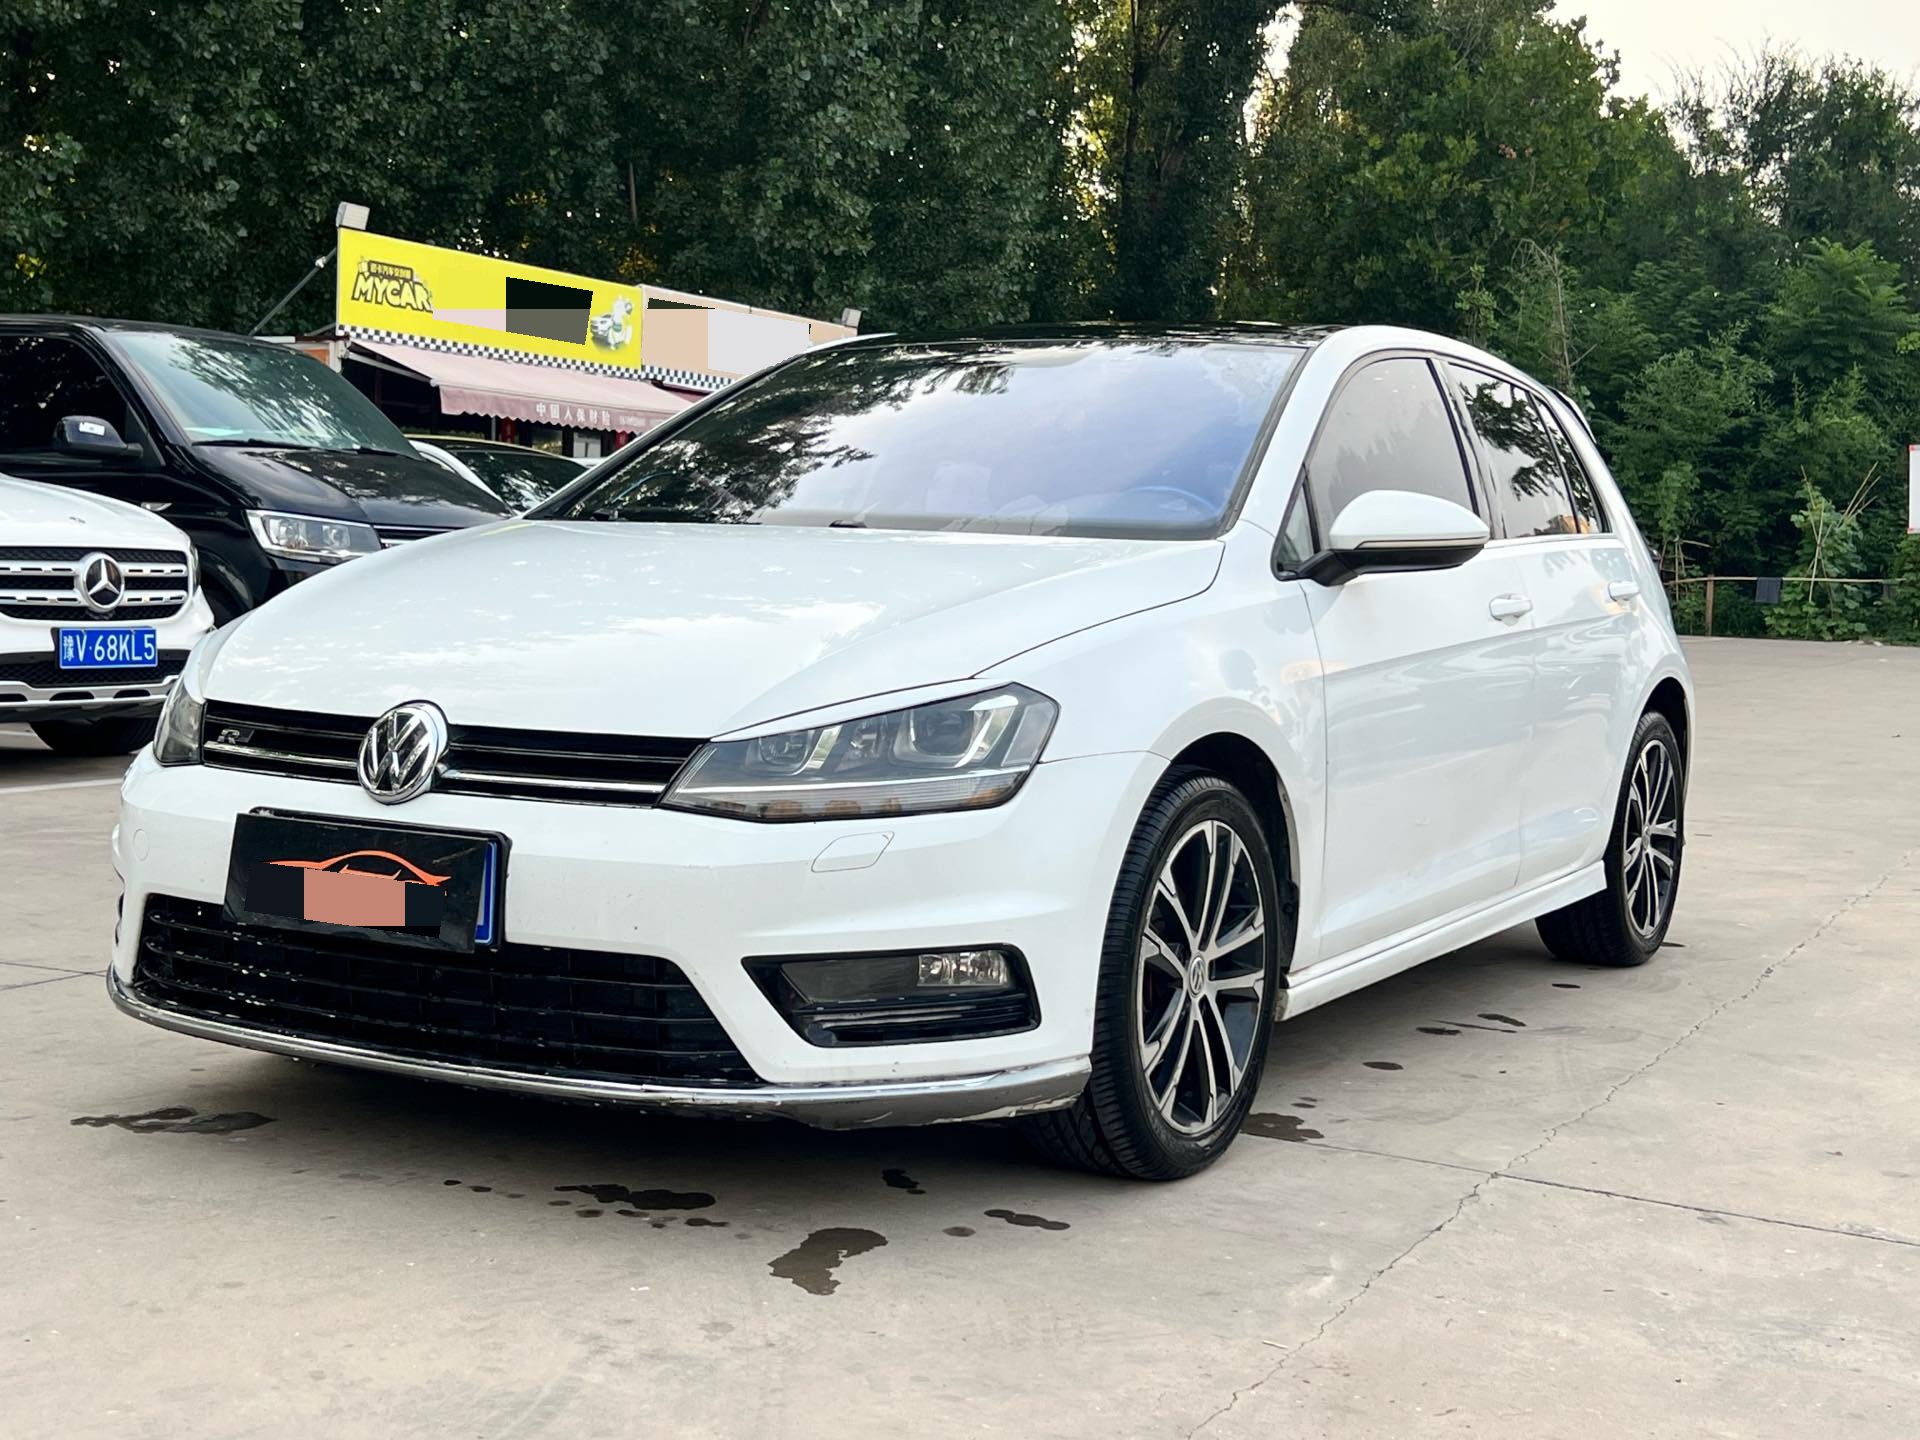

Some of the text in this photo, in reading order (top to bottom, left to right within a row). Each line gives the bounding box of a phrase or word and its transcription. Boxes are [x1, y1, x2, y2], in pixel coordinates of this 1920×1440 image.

[351, 271, 433, 313] MYCAR
[535, 401, 611, 426] 中国人保财险
